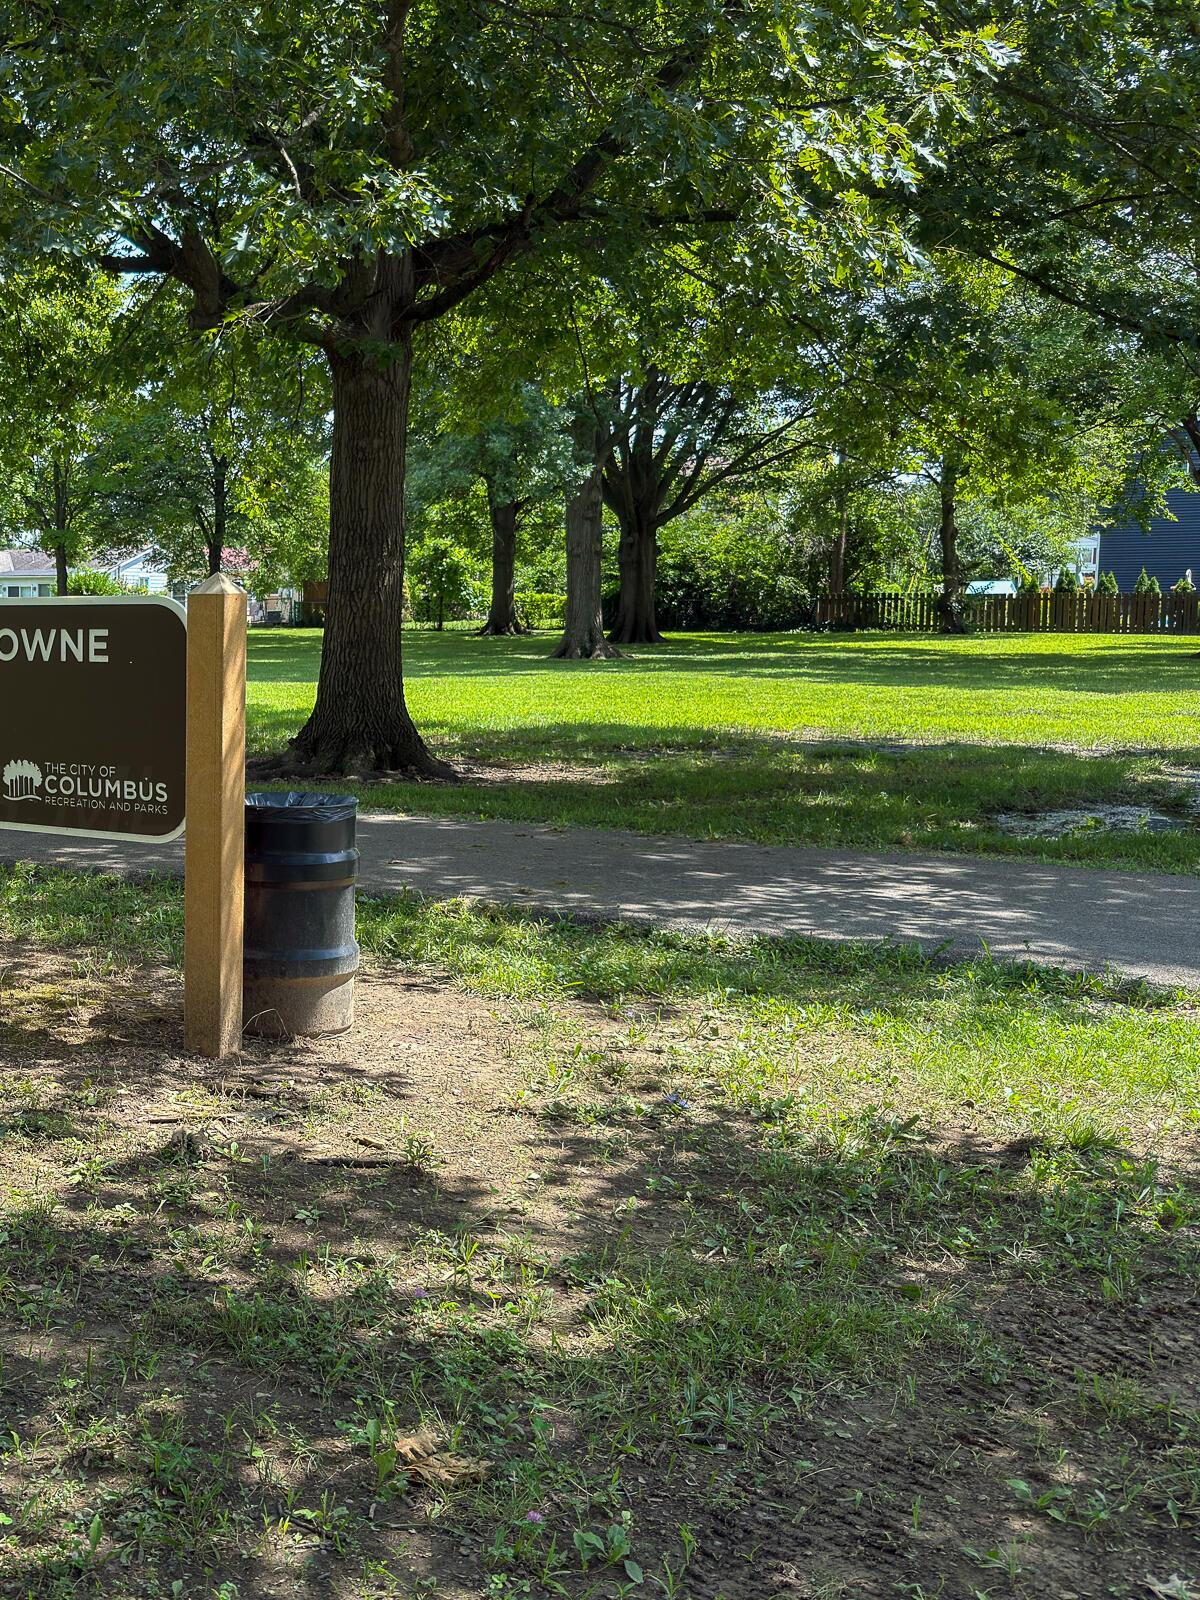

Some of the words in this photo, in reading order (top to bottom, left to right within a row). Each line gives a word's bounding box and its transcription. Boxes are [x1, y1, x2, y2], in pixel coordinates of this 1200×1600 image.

[44, 761, 67, 775] THE
[69, 763, 96, 776] CITY
[99, 765, 117, 778] OF
[44, 774, 169, 803] COLUMBUS
[44, 794, 106, 809] RECREATION
[109, 801, 131, 812] AND
[134, 803, 169, 816] PARKS
